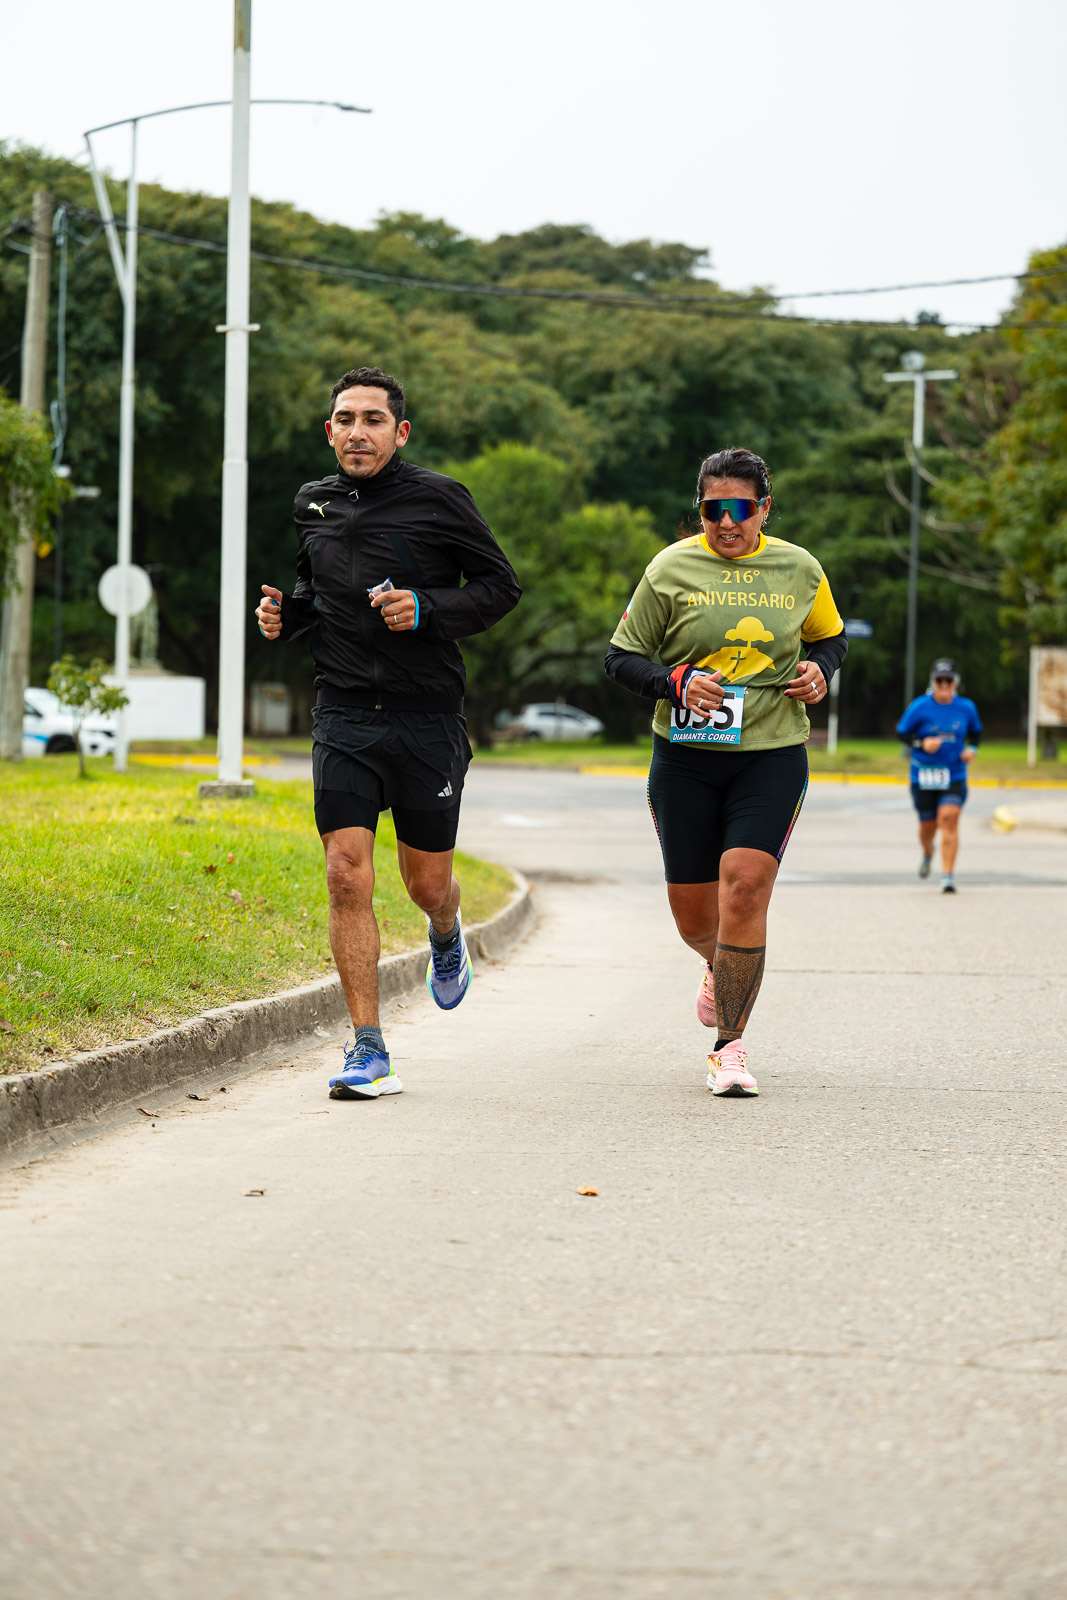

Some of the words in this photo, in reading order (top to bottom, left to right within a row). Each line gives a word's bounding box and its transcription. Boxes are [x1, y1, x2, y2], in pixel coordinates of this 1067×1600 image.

[721, 570, 760, 584] 216°
[687, 591, 795, 610] ANIVERSARIO
[707, 733, 736, 741] CORRE
